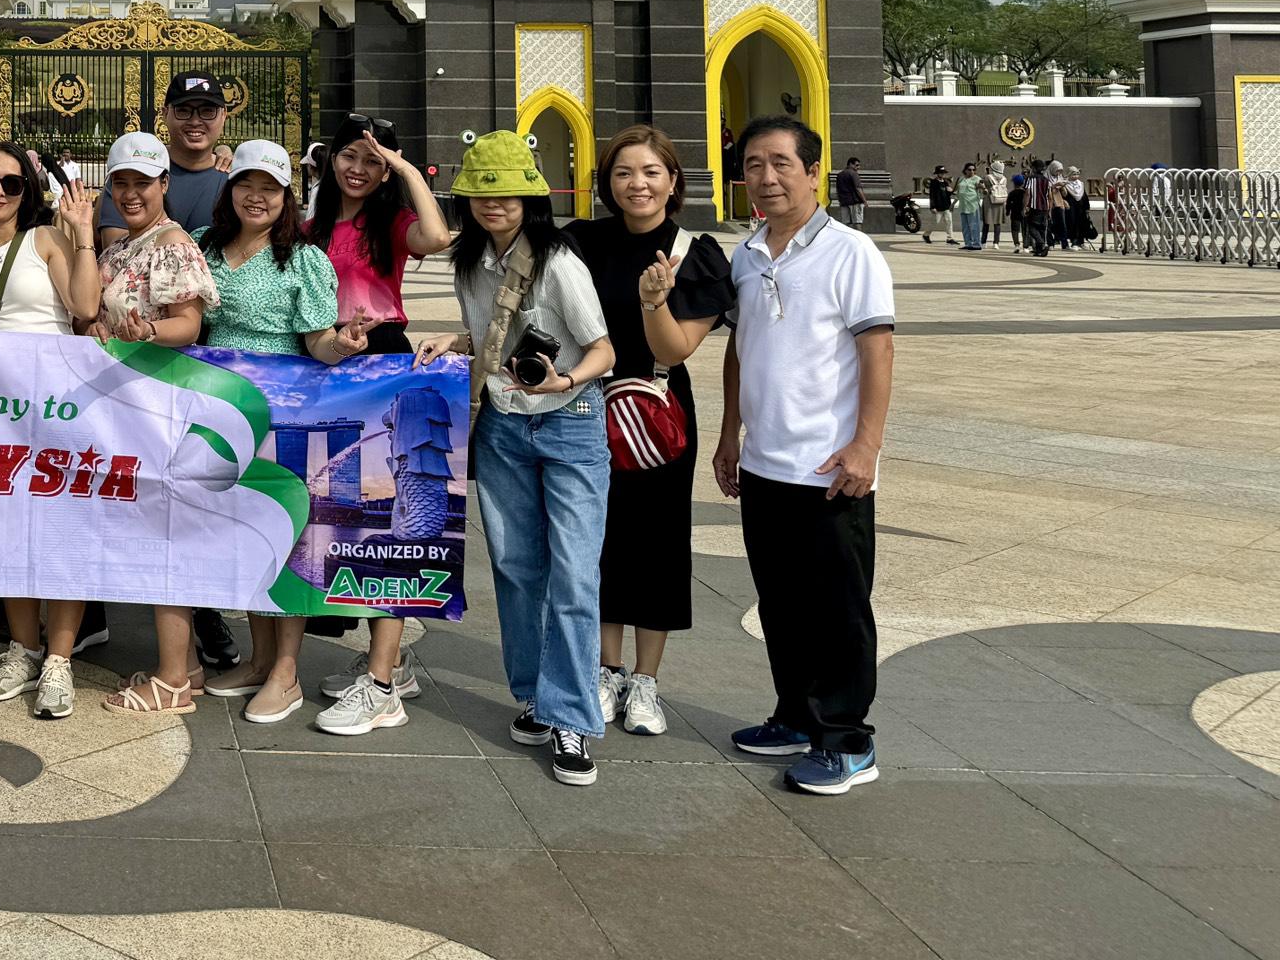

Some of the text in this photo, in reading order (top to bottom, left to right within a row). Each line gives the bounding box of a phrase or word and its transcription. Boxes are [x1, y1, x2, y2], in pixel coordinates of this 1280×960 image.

[43, 394, 78, 421] to
[328, 542, 450, 560] ORGANIZED BY
